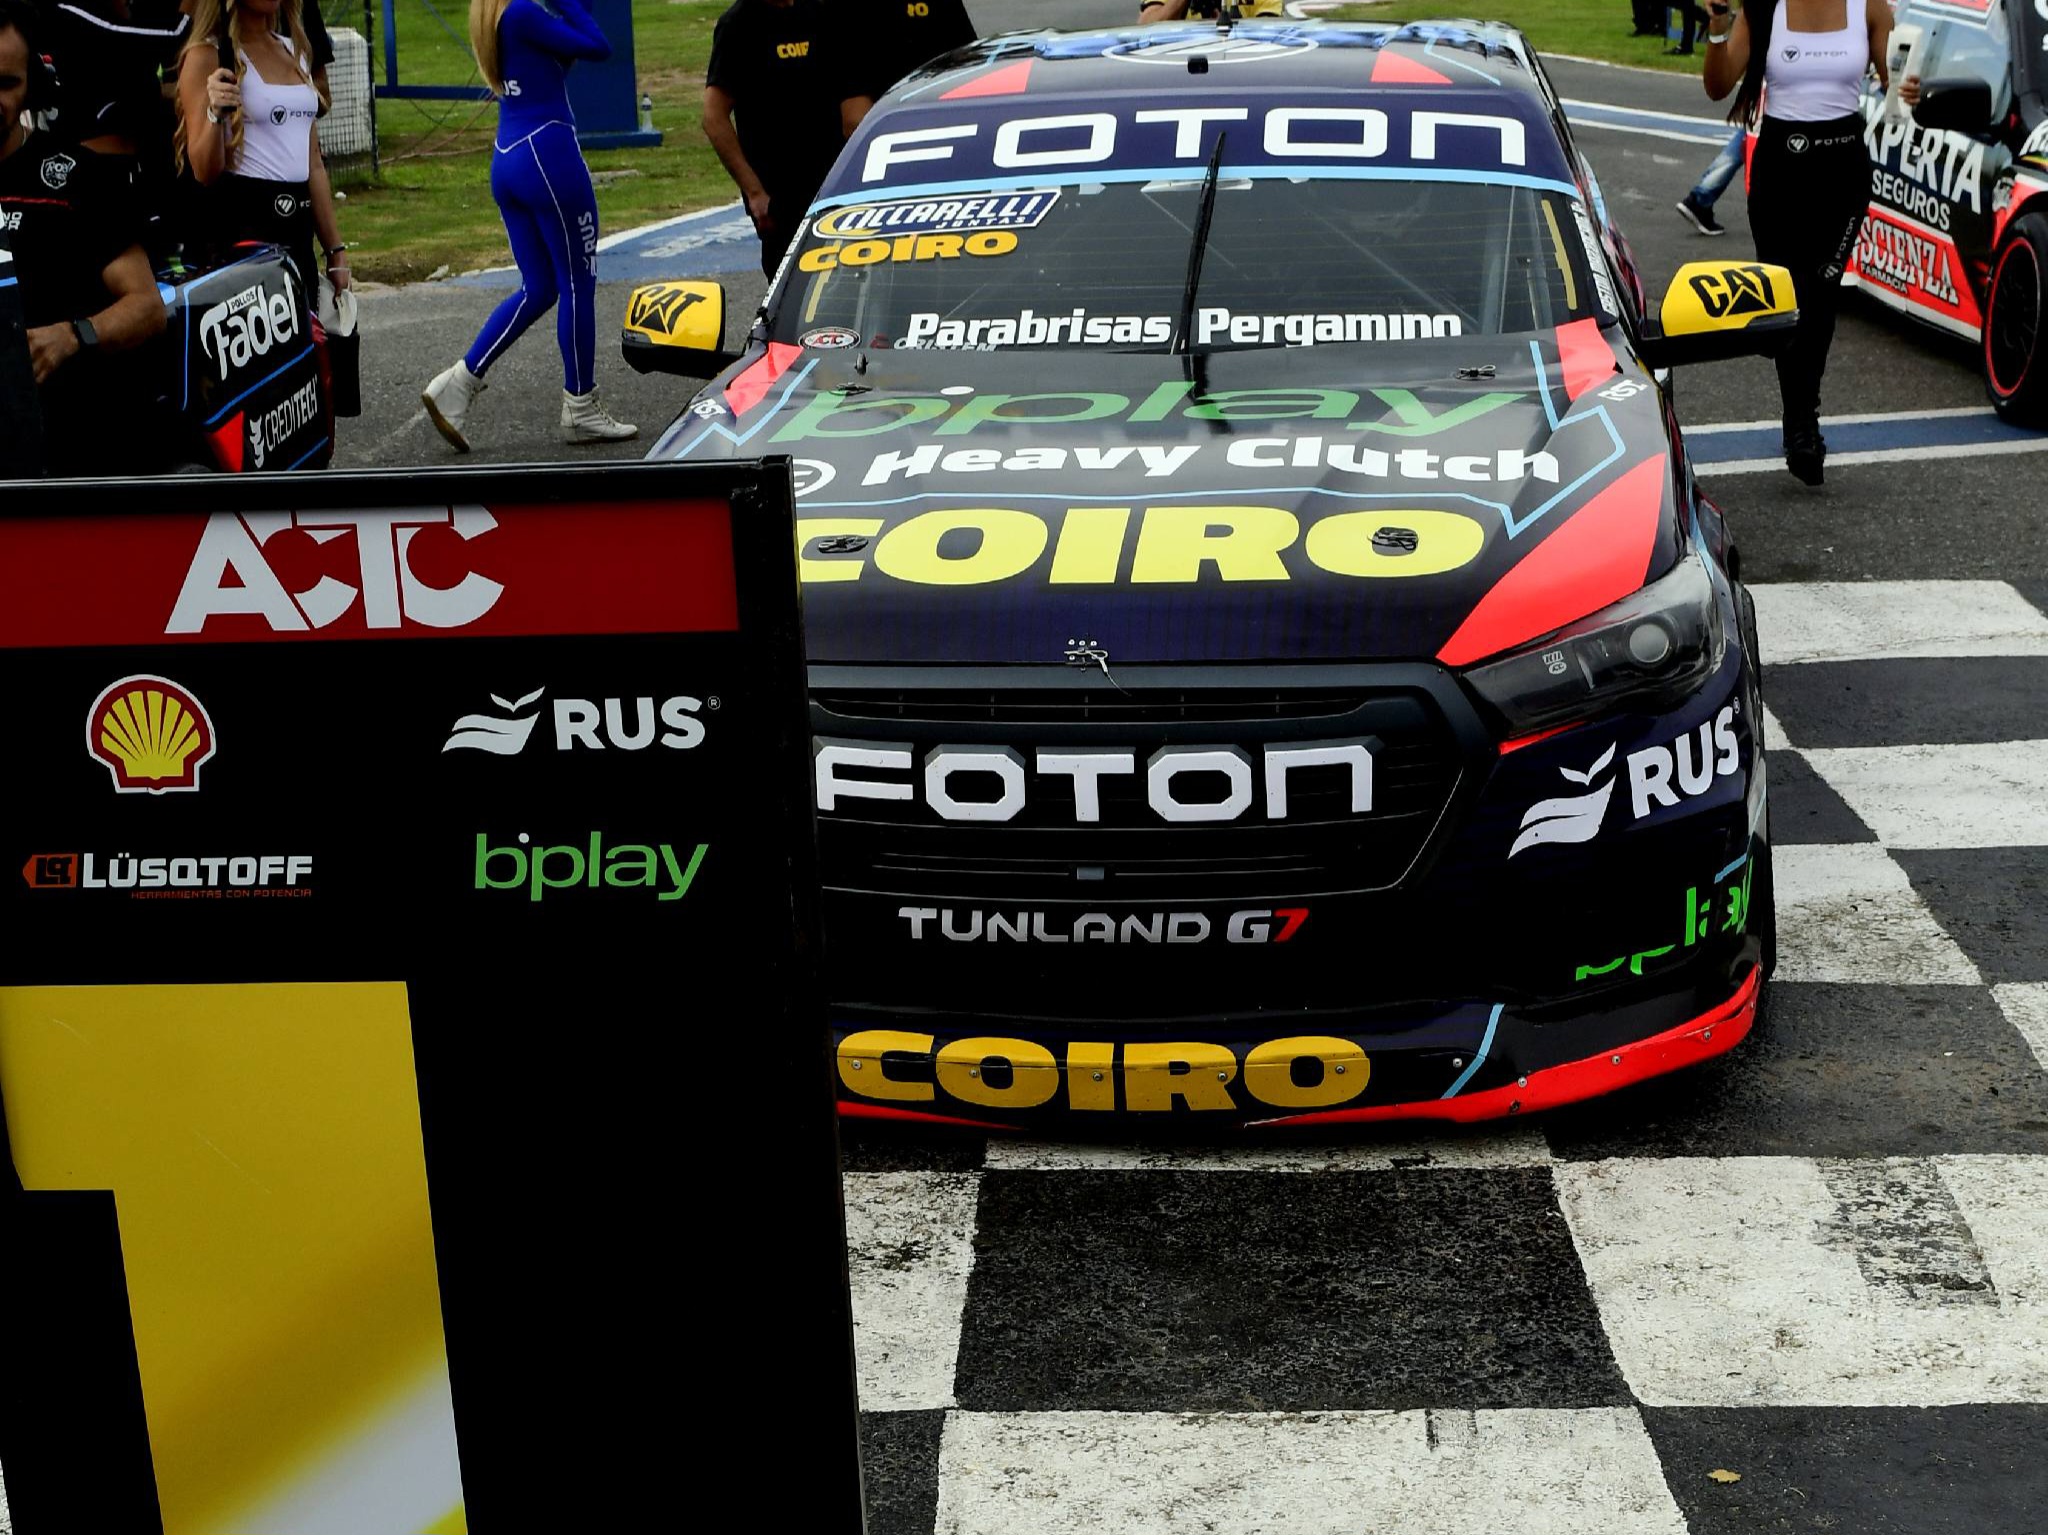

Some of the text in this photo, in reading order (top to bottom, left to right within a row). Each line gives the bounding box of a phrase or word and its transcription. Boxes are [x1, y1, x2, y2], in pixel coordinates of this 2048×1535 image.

[861, 107, 1527, 183] FOTON
[1815, 135, 1855, 146] FOTON
[837, 194, 1040, 231] CICCARELLI
[935, 216, 1028, 229] JUNTAS
[1871, 168, 1951, 231] SEGUROS
[578, 211, 598, 254] RUS
[799, 231, 1018, 272] COIRO
[231, 290, 256, 309] POLLOS
[1689, 266, 1776, 318] CAT
[1861, 262, 1908, 293] FARMACIA
[200, 272, 299, 381] Fadel
[629, 286, 706, 336] CAT
[906, 308, 1172, 348] Parabrisas
[1198, 308, 1462, 347] Pergamino
[265, 377, 318, 452] CREDITECH
[769, 381, 1528, 442] bplay
[861, 436, 1559, 485] Heavy Clutch
[163, 505, 505, 634] ACTC
[797, 507, 1486, 585] COIRO
[814, 742, 1374, 822] FOTON
[83, 853, 312, 888] LÜSQTOFF
[474, 831, 710, 901] bplay
[131, 888, 312, 899] HERRAMIENTAS CON POTENCIA
[898, 907, 1310, 943] TUNLAND G7
[836, 1029, 1371, 1111] COIRO
[0, 980, 468, 1535] 1
